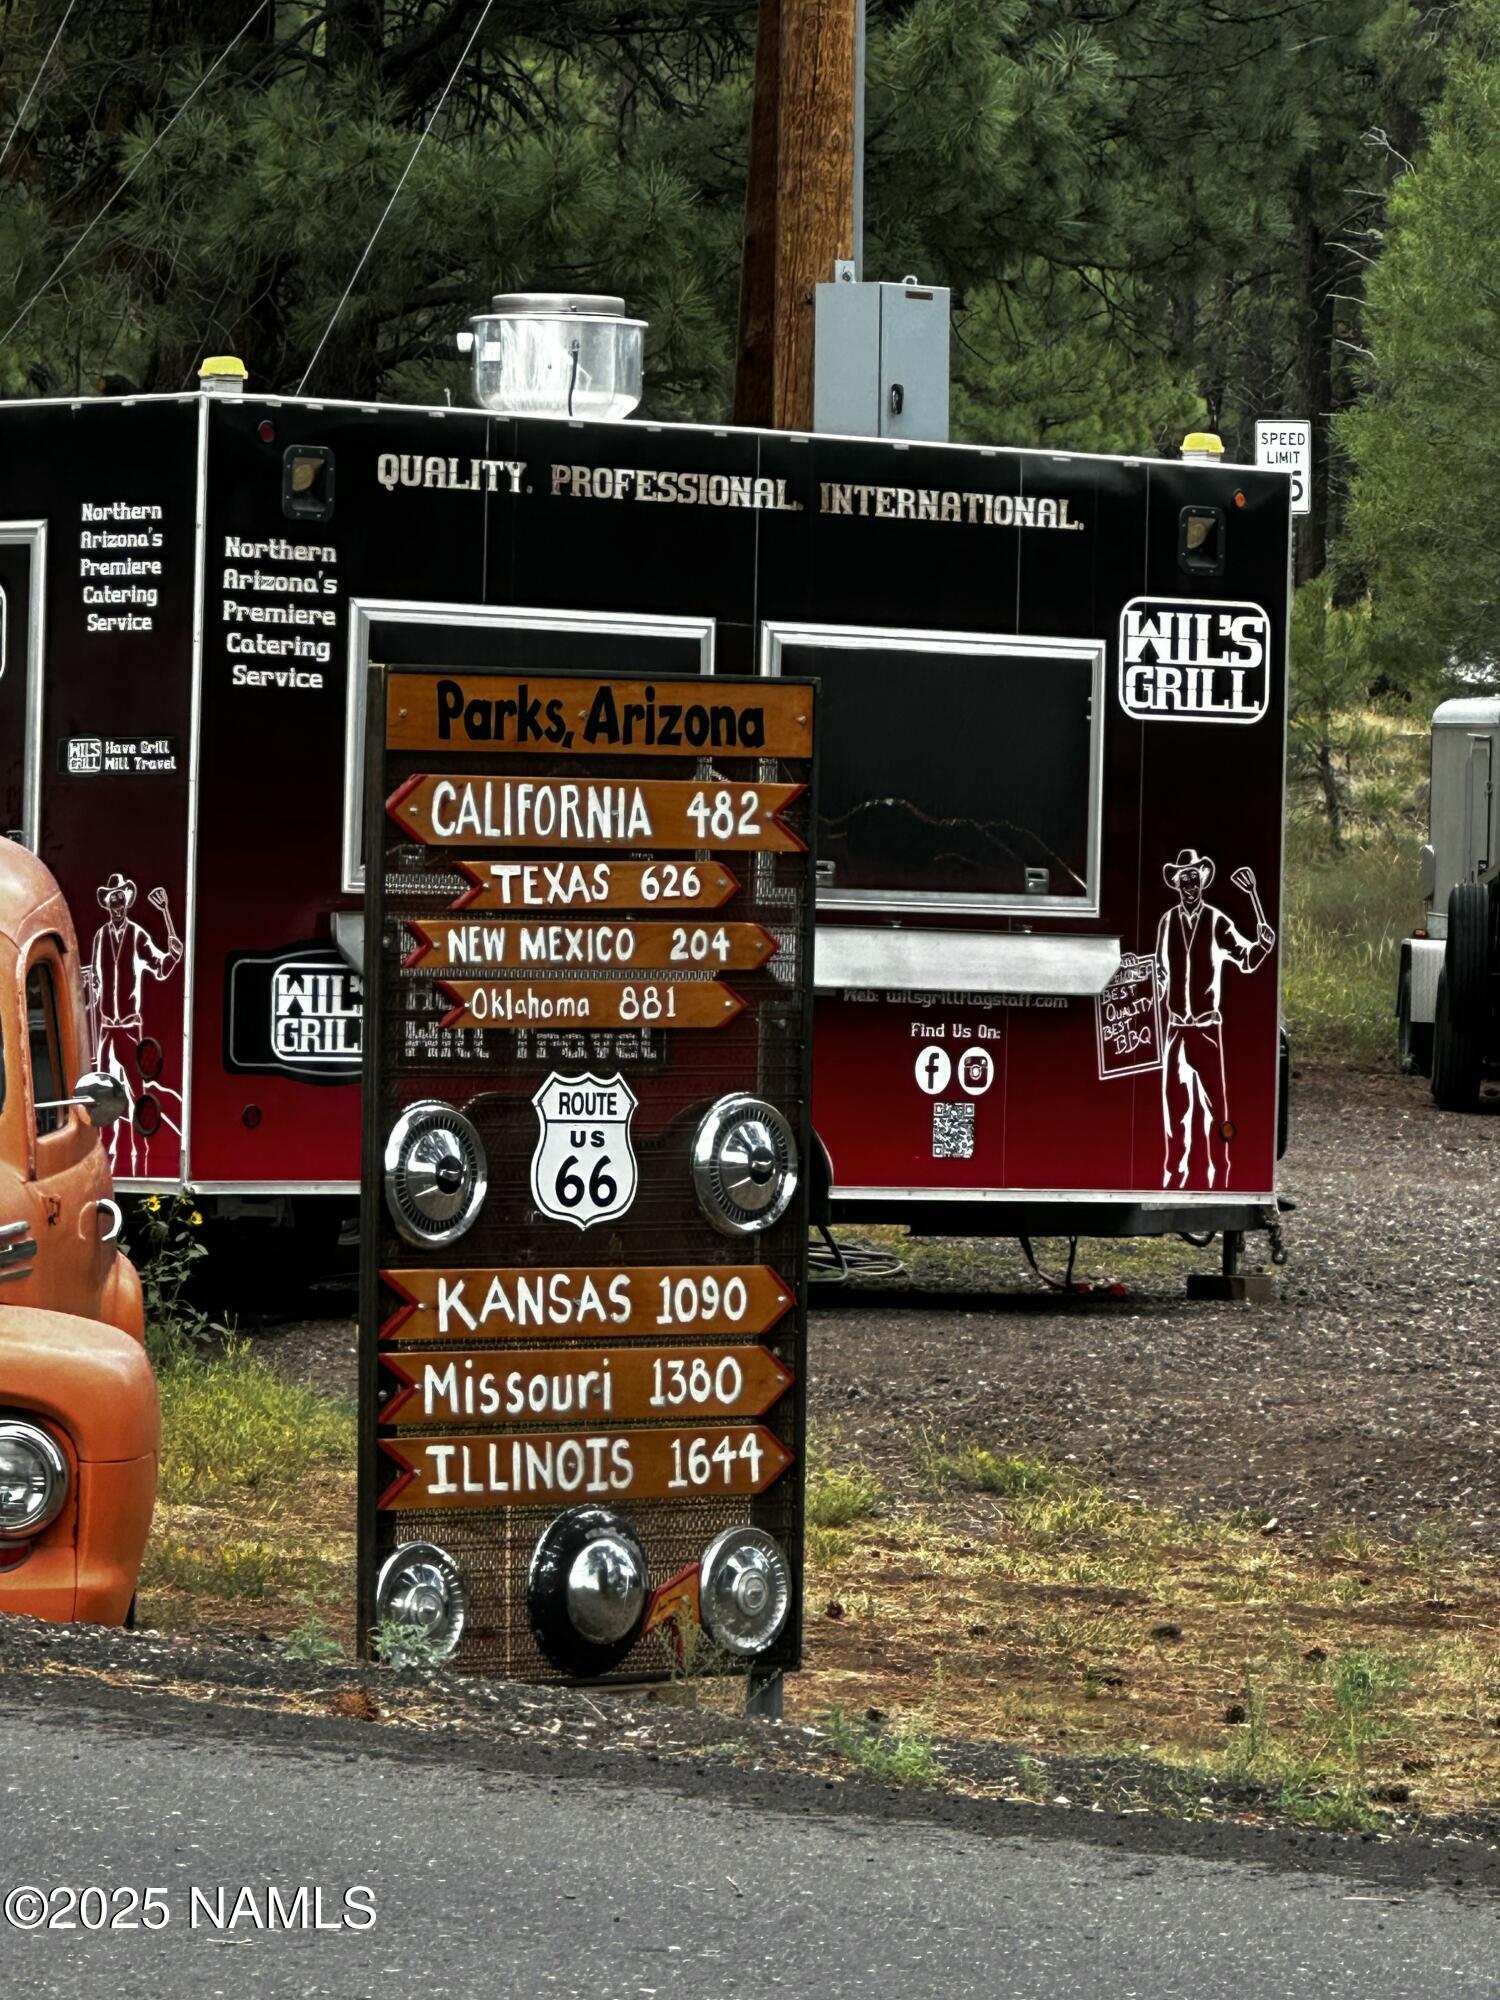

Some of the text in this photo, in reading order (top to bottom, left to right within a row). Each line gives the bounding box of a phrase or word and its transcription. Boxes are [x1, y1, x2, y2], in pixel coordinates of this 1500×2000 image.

[1260, 432, 1306, 446] SPEED
[1266, 451, 1300, 464] LIMIT
[377, 453, 1085, 531] QUALITY. PROFESSIONAL. INTERNATIONAL.
[81, 502, 163, 521] Northern
[80, 526, 163, 549] Arizona's
[224, 536, 338, 563] Northern
[79, 557, 162, 577] Premiere
[222, 568, 338, 594] Arizona's
[83, 584, 158, 607] Catering
[87, 612, 152, 632] Service
[222, 599, 337, 626] Premiere
[226, 632, 331, 662] Catering
[1124, 610, 1268, 668] WIL'S
[232, 664, 324, 689] Service
[1124, 665, 1264, 714] GRILL
[436, 679, 767, 749] Parks, Arizona
[105, 740, 170, 754] Have Grill
[69, 757, 101, 770] GRILL
[105, 756, 177, 770] Will Travel
[430, 780, 762, 841] CALIFORNIA 482
[490, 862, 702, 905] TEXAS 626
[447, 926, 731, 963] NEW MEXICO 204
[274, 974, 364, 1017] WIL'
[470, 987, 590, 1021] Oklahoma
[619, 985, 678, 1021] 881
[1101, 984, 1137, 1005] BEST
[1106, 996, 1154, 1022] QUALITY
[274, 1017, 364, 1053] GRIL
[910, 1022, 1001, 1039] Find Us On:
[1102, 1017, 1133, 1042] BEST
[1113, 1026, 1152, 1055] BBQ
[558, 1091, 617, 1117] ROUTE
[570, 1130, 606, 1149] US
[555, 1155, 618, 1208] 66
[438, 1273, 747, 1332] KANSAS 1090
[423, 1355, 742, 1415] Missouri 1380
[425, 1432, 764, 1495] ILLINOIS 1644
